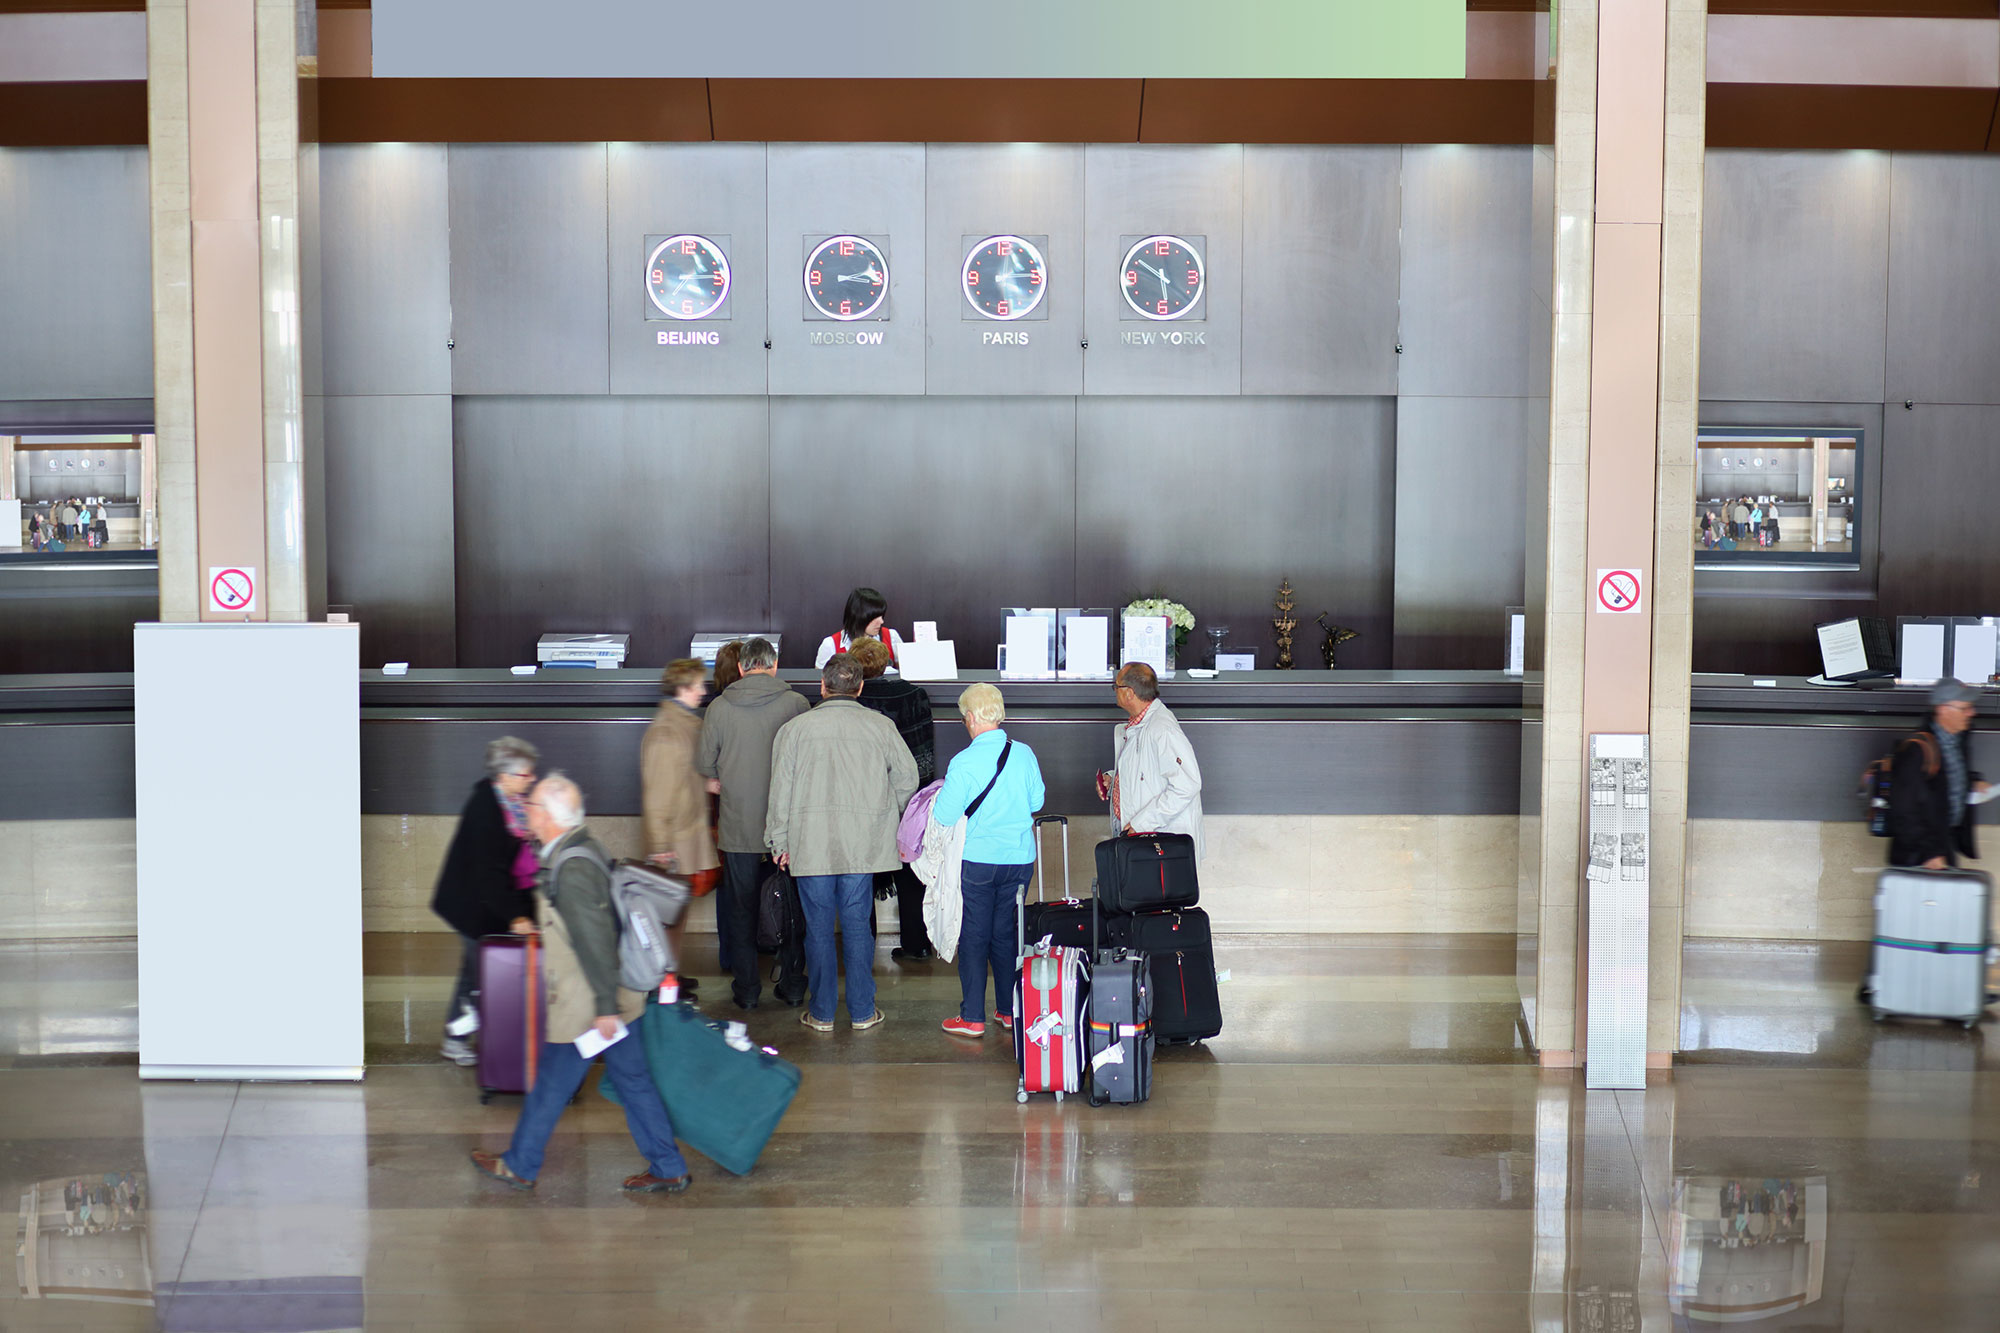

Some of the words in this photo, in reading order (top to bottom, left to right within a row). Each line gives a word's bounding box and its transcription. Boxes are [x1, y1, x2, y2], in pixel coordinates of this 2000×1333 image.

[681, 240, 697, 255] 12
[839, 240, 855, 256] 12
[997, 241, 1012, 256] 12
[1155, 240, 1170, 256] 12
[652, 269, 663, 285] 9
[713, 270, 725, 286] 3
[810, 270, 822, 285] 9
[872, 270, 883, 286] 3
[968, 270, 979, 286] 9
[1030, 269, 1042, 285] 3
[1126, 270, 1137, 286] 9
[1188, 270, 1199, 285] 3
[682, 299, 693, 315] 6
[840, 300, 851, 315] 6
[998, 300, 1008, 316] 6
[1157, 300, 1168, 315] 6
[657, 331, 720, 345] BEIJING
[810, 331, 884, 345] MOSCOW
[983, 331, 1029, 345] PARIS
[1120, 331, 1156, 345] NEW
[1160, 331, 1206, 345] YORK
